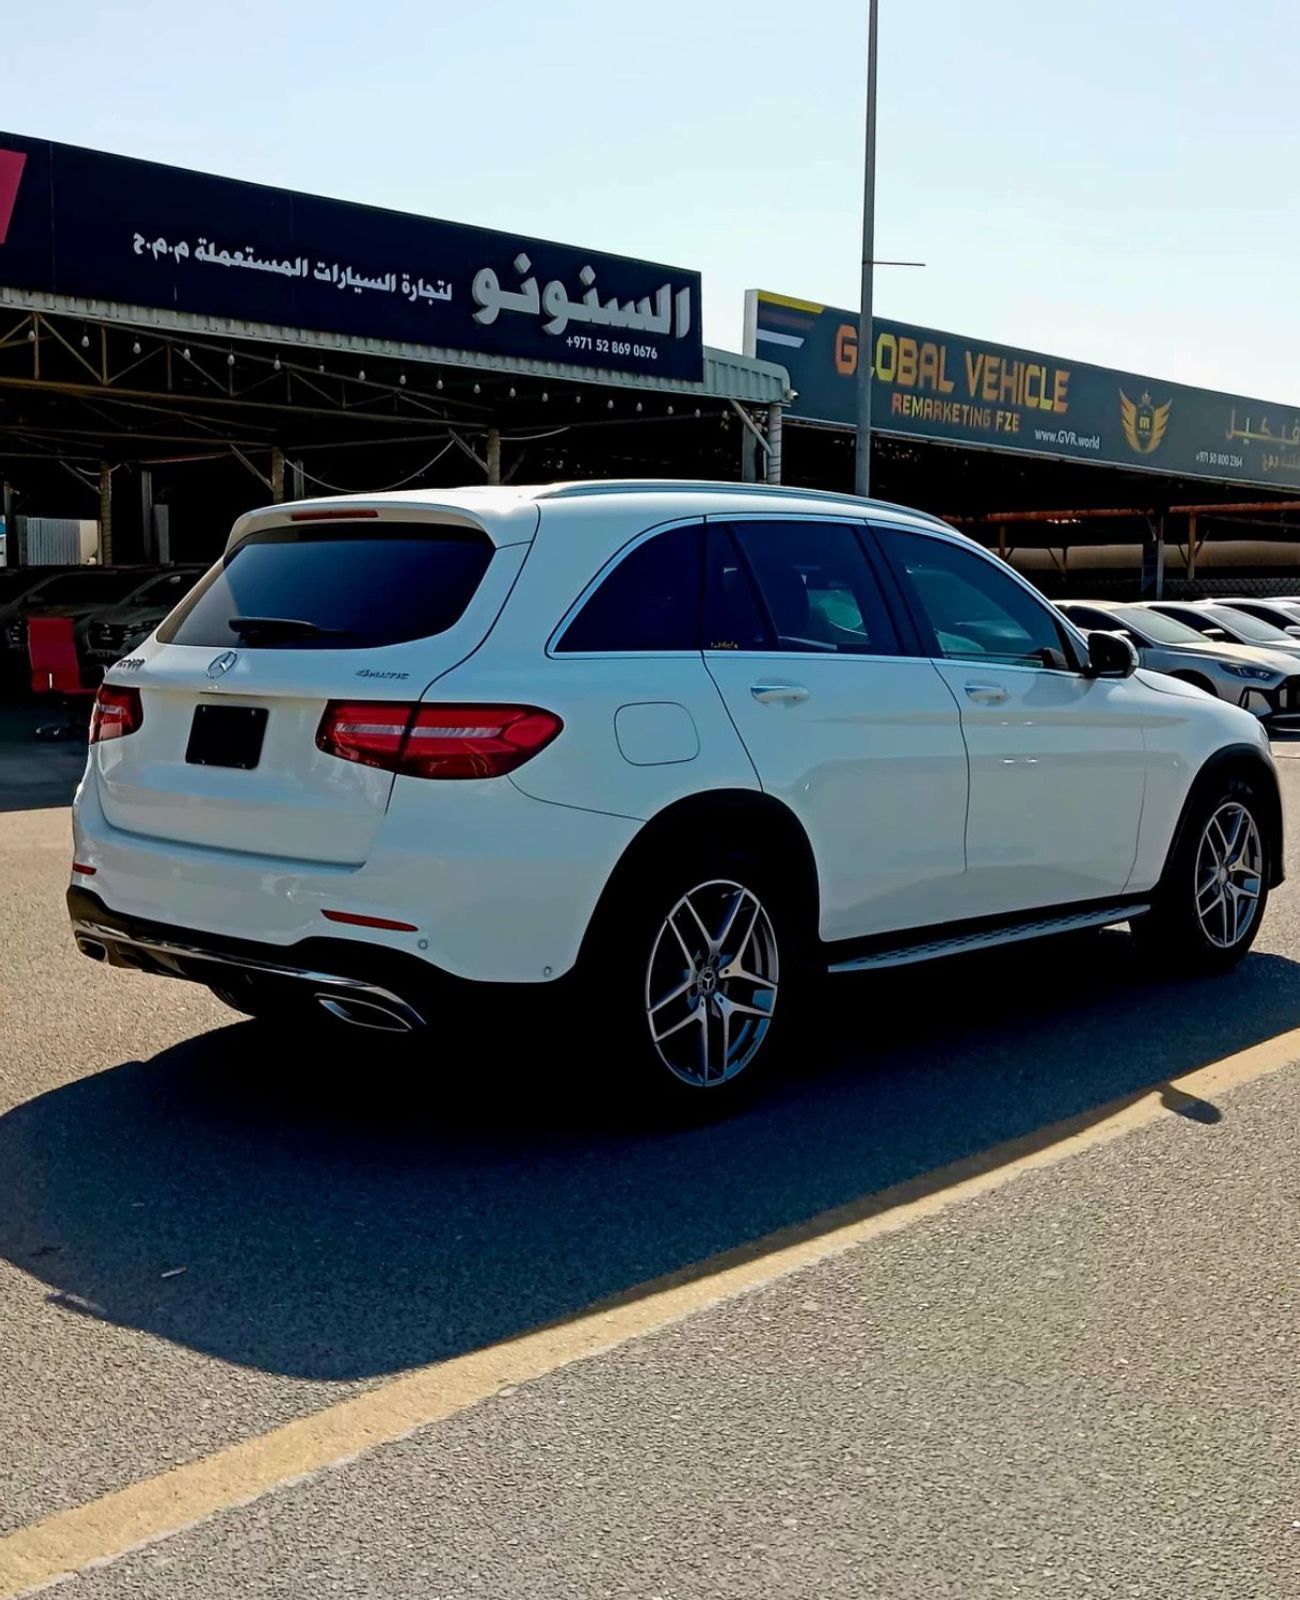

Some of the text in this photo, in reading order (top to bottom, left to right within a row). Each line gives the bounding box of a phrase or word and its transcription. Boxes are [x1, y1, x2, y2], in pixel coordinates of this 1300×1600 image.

[194, 237, 309, 278] المستعملة
[313, 261, 397, 294] السيارات
[401, 273, 453, 305] لتجارة
[471, 252, 691, 339] السنونو
[566, 336, 658, 359] +971 52 869 0676
[835, 323, 1071, 414] GOBAL VEHICLE
[892, 392, 1021, 433] REMARKETING FZE
[1034, 428, 1101, 450] www.GVR.world
